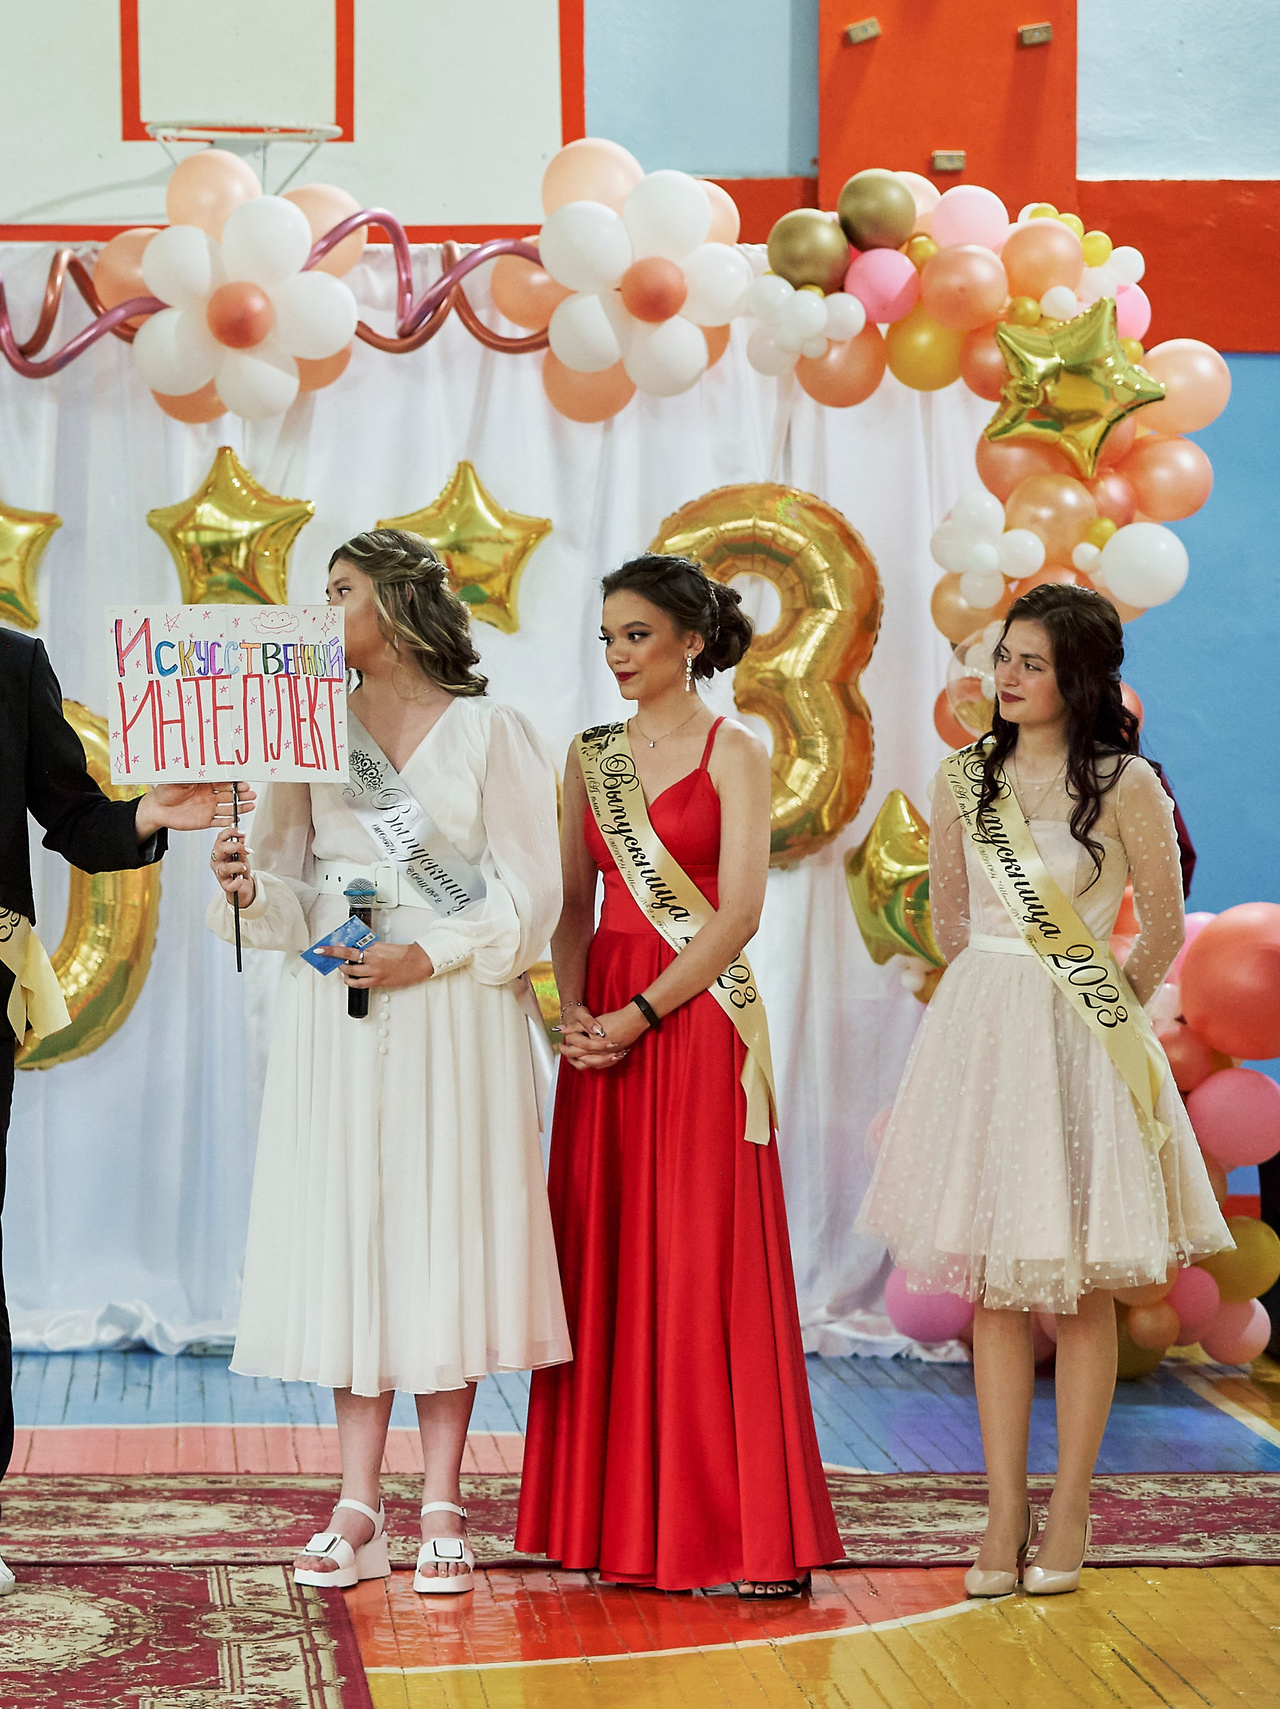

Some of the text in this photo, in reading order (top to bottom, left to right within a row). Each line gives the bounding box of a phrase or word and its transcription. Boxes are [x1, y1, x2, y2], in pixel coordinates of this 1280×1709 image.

[117, 673, 344, 774] ИНТЕЛЛЕКТ
[370, 787, 471, 912] Выпускниц
[599, 753, 690, 923] Выпускница
[1047, 943, 1128, 1028] 2023
